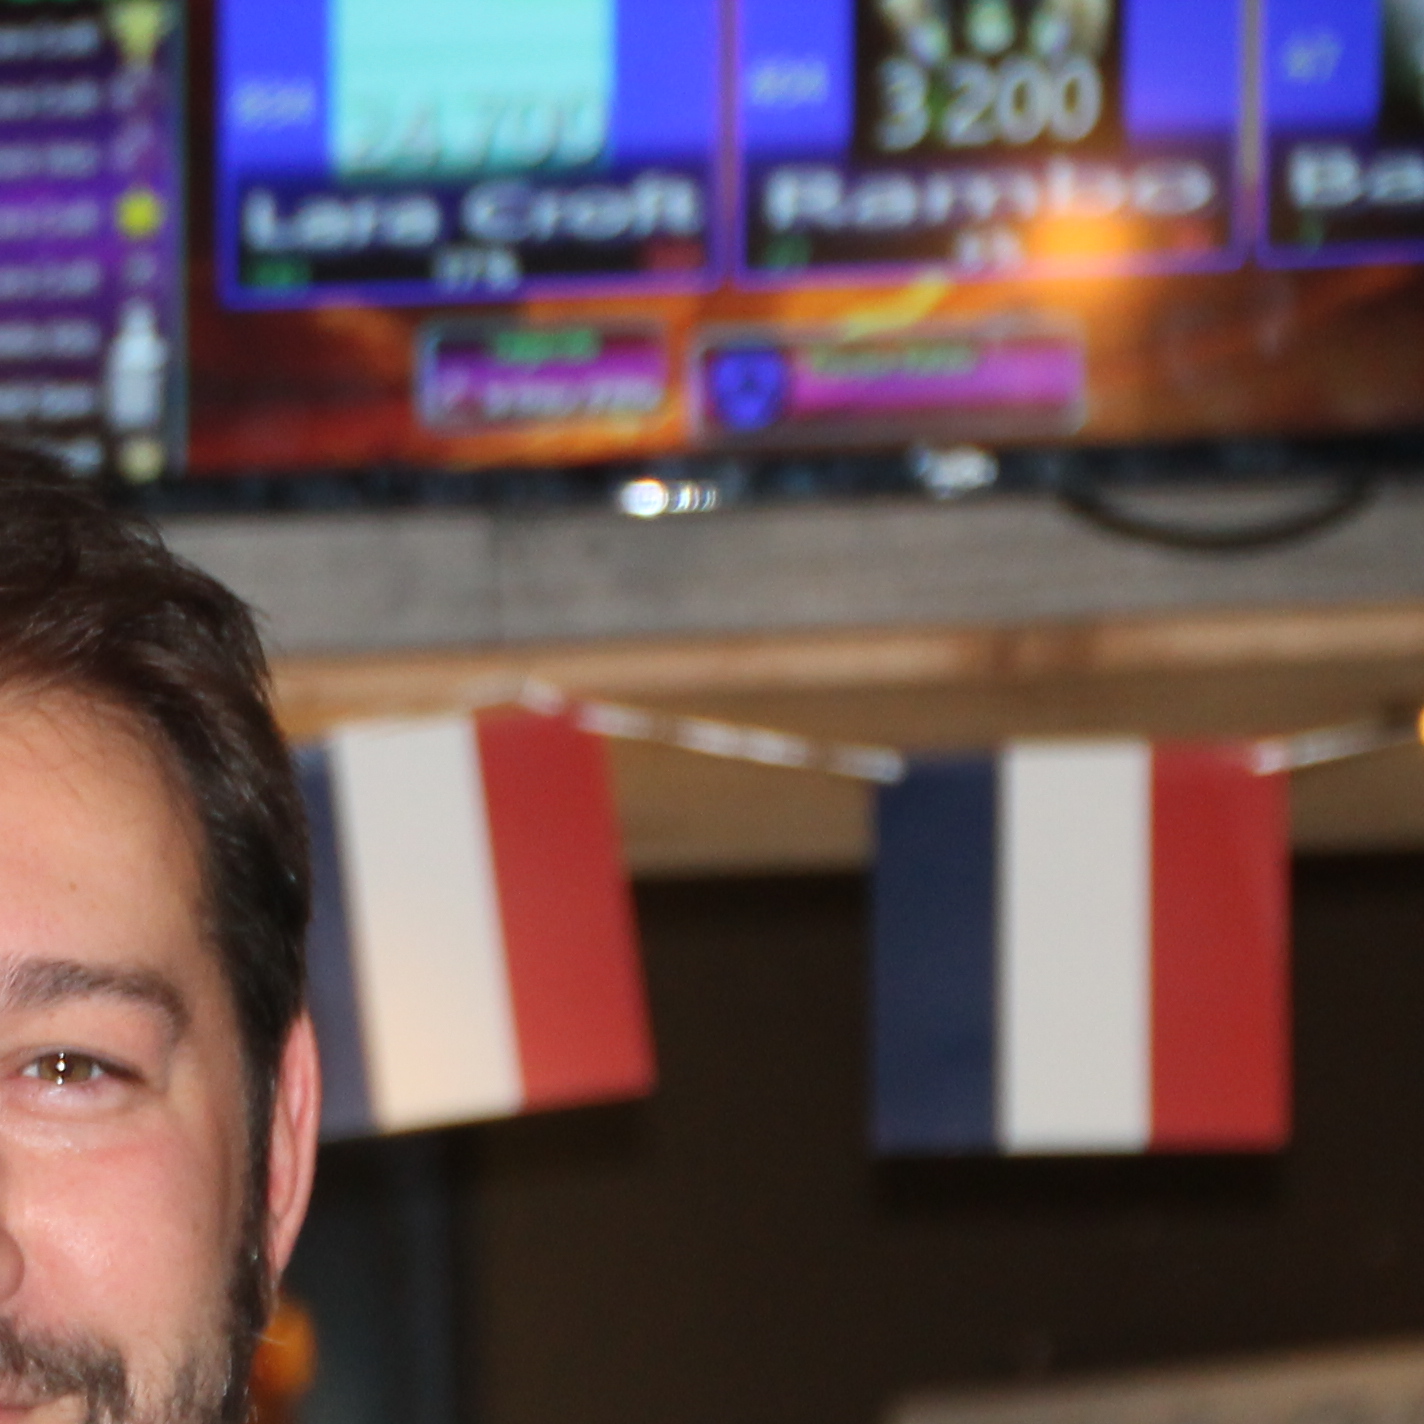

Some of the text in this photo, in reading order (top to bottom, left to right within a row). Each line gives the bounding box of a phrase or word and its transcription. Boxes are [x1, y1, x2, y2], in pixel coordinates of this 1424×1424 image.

[241, 168, 700, 252] Lara Croft
[763, 158, 1217, 230] Rambo
